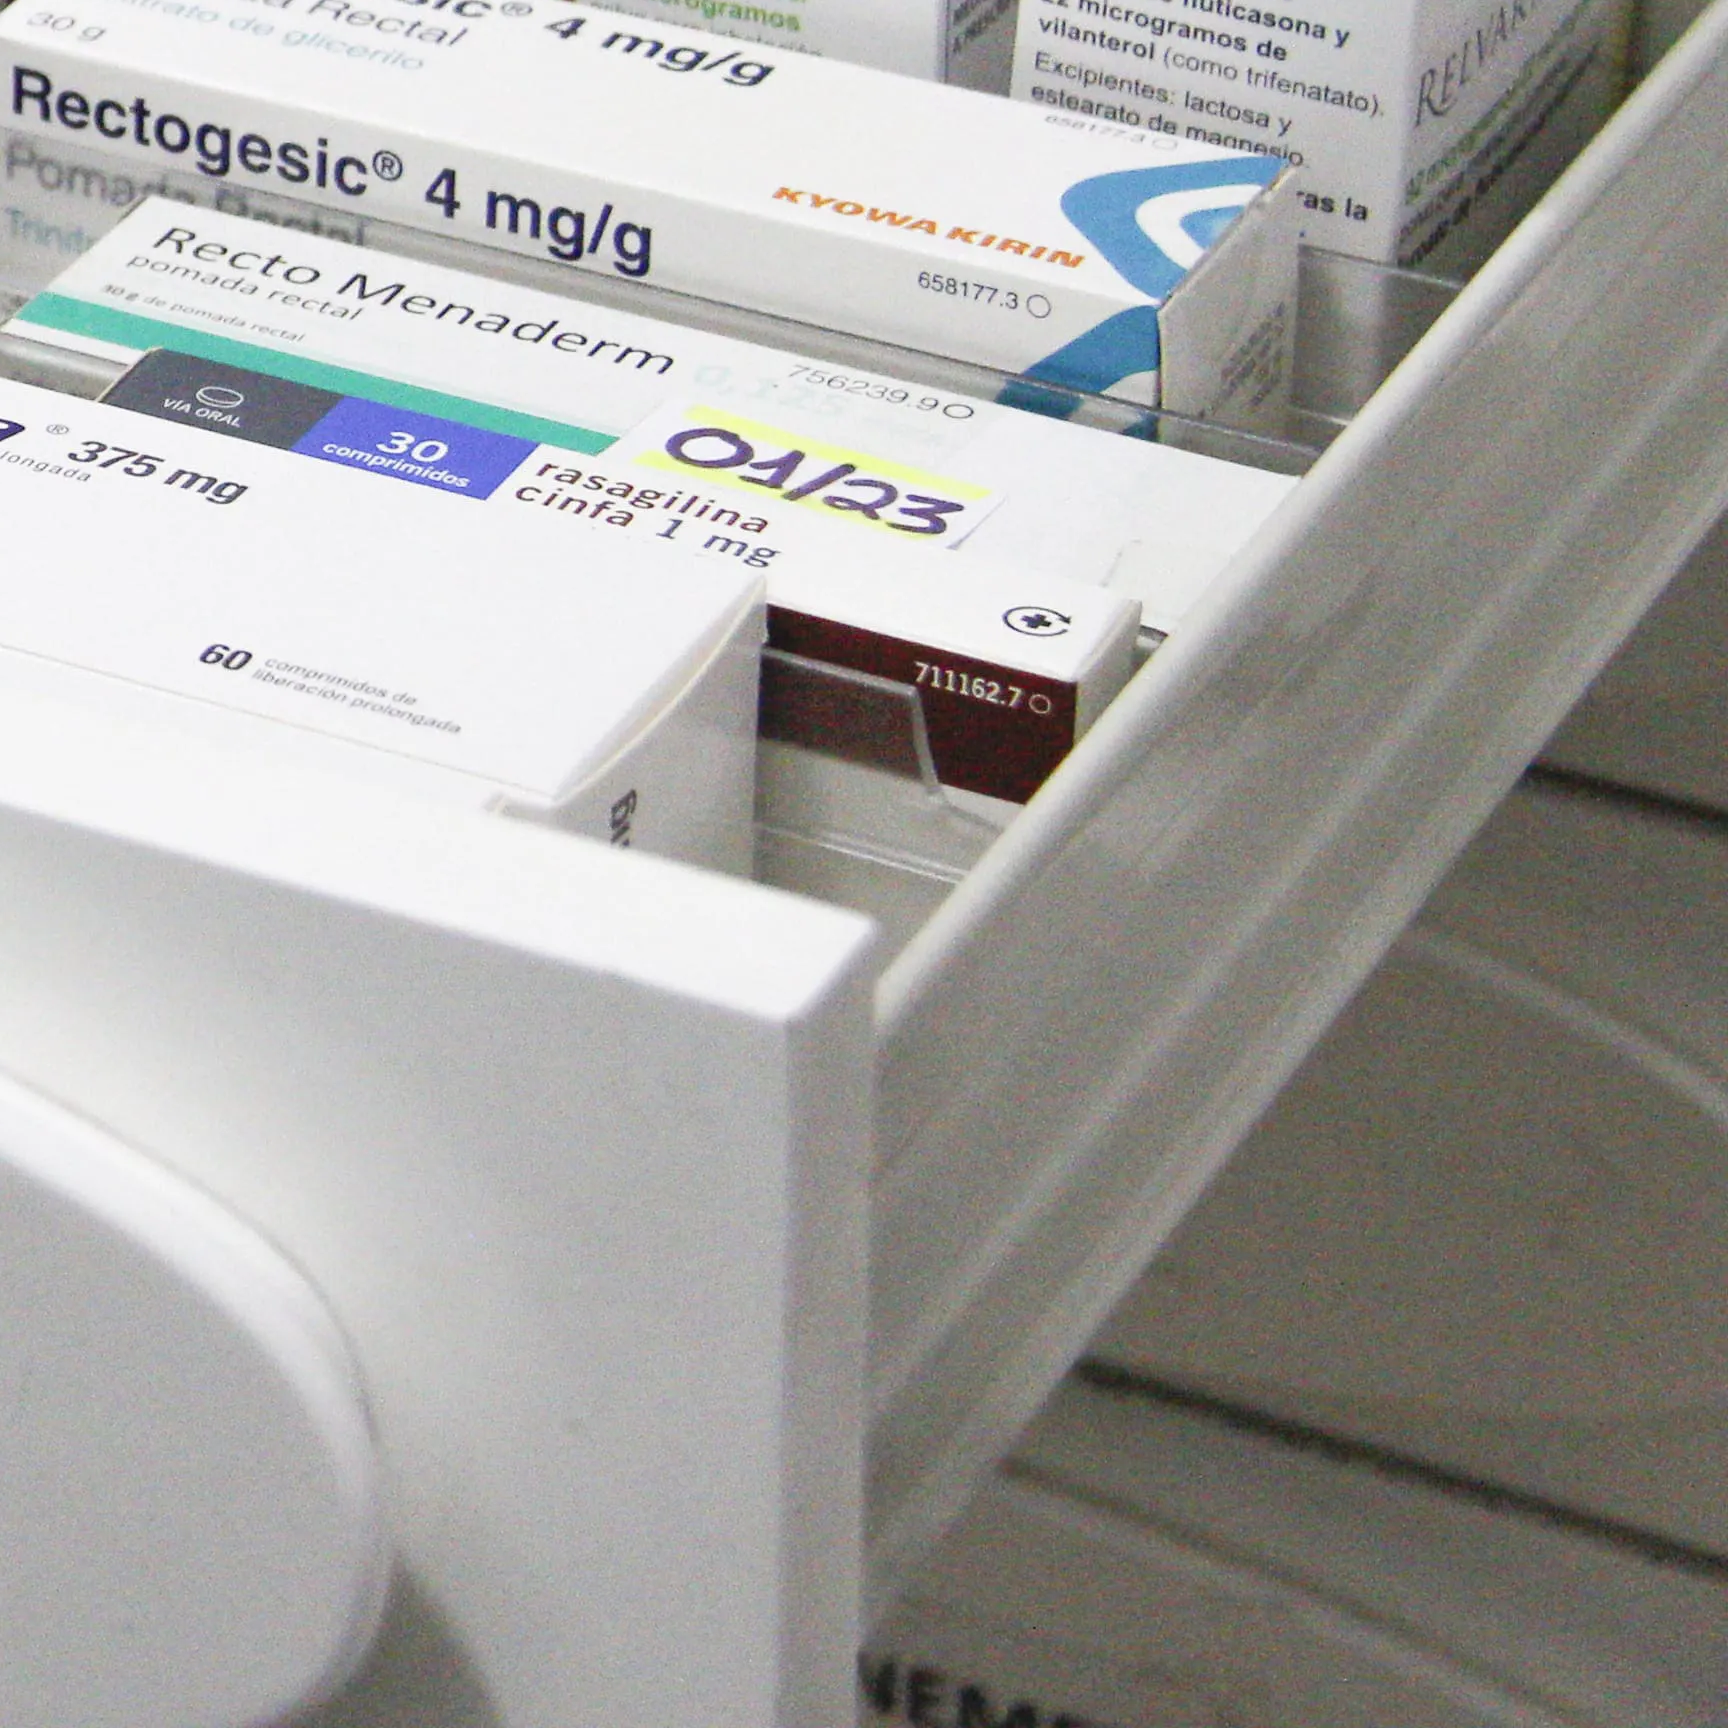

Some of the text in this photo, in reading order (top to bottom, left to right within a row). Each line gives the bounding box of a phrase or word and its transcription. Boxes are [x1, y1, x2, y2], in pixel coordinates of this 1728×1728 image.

[26, 12, 107, 44] 30 g
[230, 13, 275, 37] de
[280, 27, 426, 72] glicerilo
[543, 15, 589, 42] 4
[600, 30, 776, 89] mg/g
[1256, 40, 1288, 63] de
[1334, 28, 1350, 48] y
[1034, 51, 1293, 137] Excipientes: lactosa y
[1039, 15, 1385, 119] vilanterol (como trifenatato).
[1032, 84, 1141, 127] estearato
[1148, 114, 1177, 135] de
[424, 167, 462, 220] 4
[485, 188, 654, 278] mg/g
[771, 185, 1087, 270] KYOWA KIRIN
[1296, 188, 1368, 221] as la
[100, 283, 124, 296] 30
[143, 294, 167, 308] de
[169, 300, 246, 330] pomada
[248, 321, 306, 344] rectal
[125, 253, 366, 322] pomada rectal
[151, 226, 678, 376] Recto Menaderm
[917, 271, 1020, 312] 658177.3
[195, 407, 242, 428] ORAL
[787, 363, 940, 419] 756239.9
[67, 439, 165, 479] 375
[163, 467, 249, 505] mg
[322, 441, 470, 489] comprimidos
[376, 431, 449, 464] 30
[536, 459, 770, 534] rasagilina
[665, 426, 965, 536] 01/23
[515, 483, 783, 569] cinfa 1 mg
[198, 643, 253, 671] 60
[263, 656, 418, 706] comprimidos de
[913, 660, 1026, 712] 711162.7
[250, 667, 463, 735] liberación prolongada
